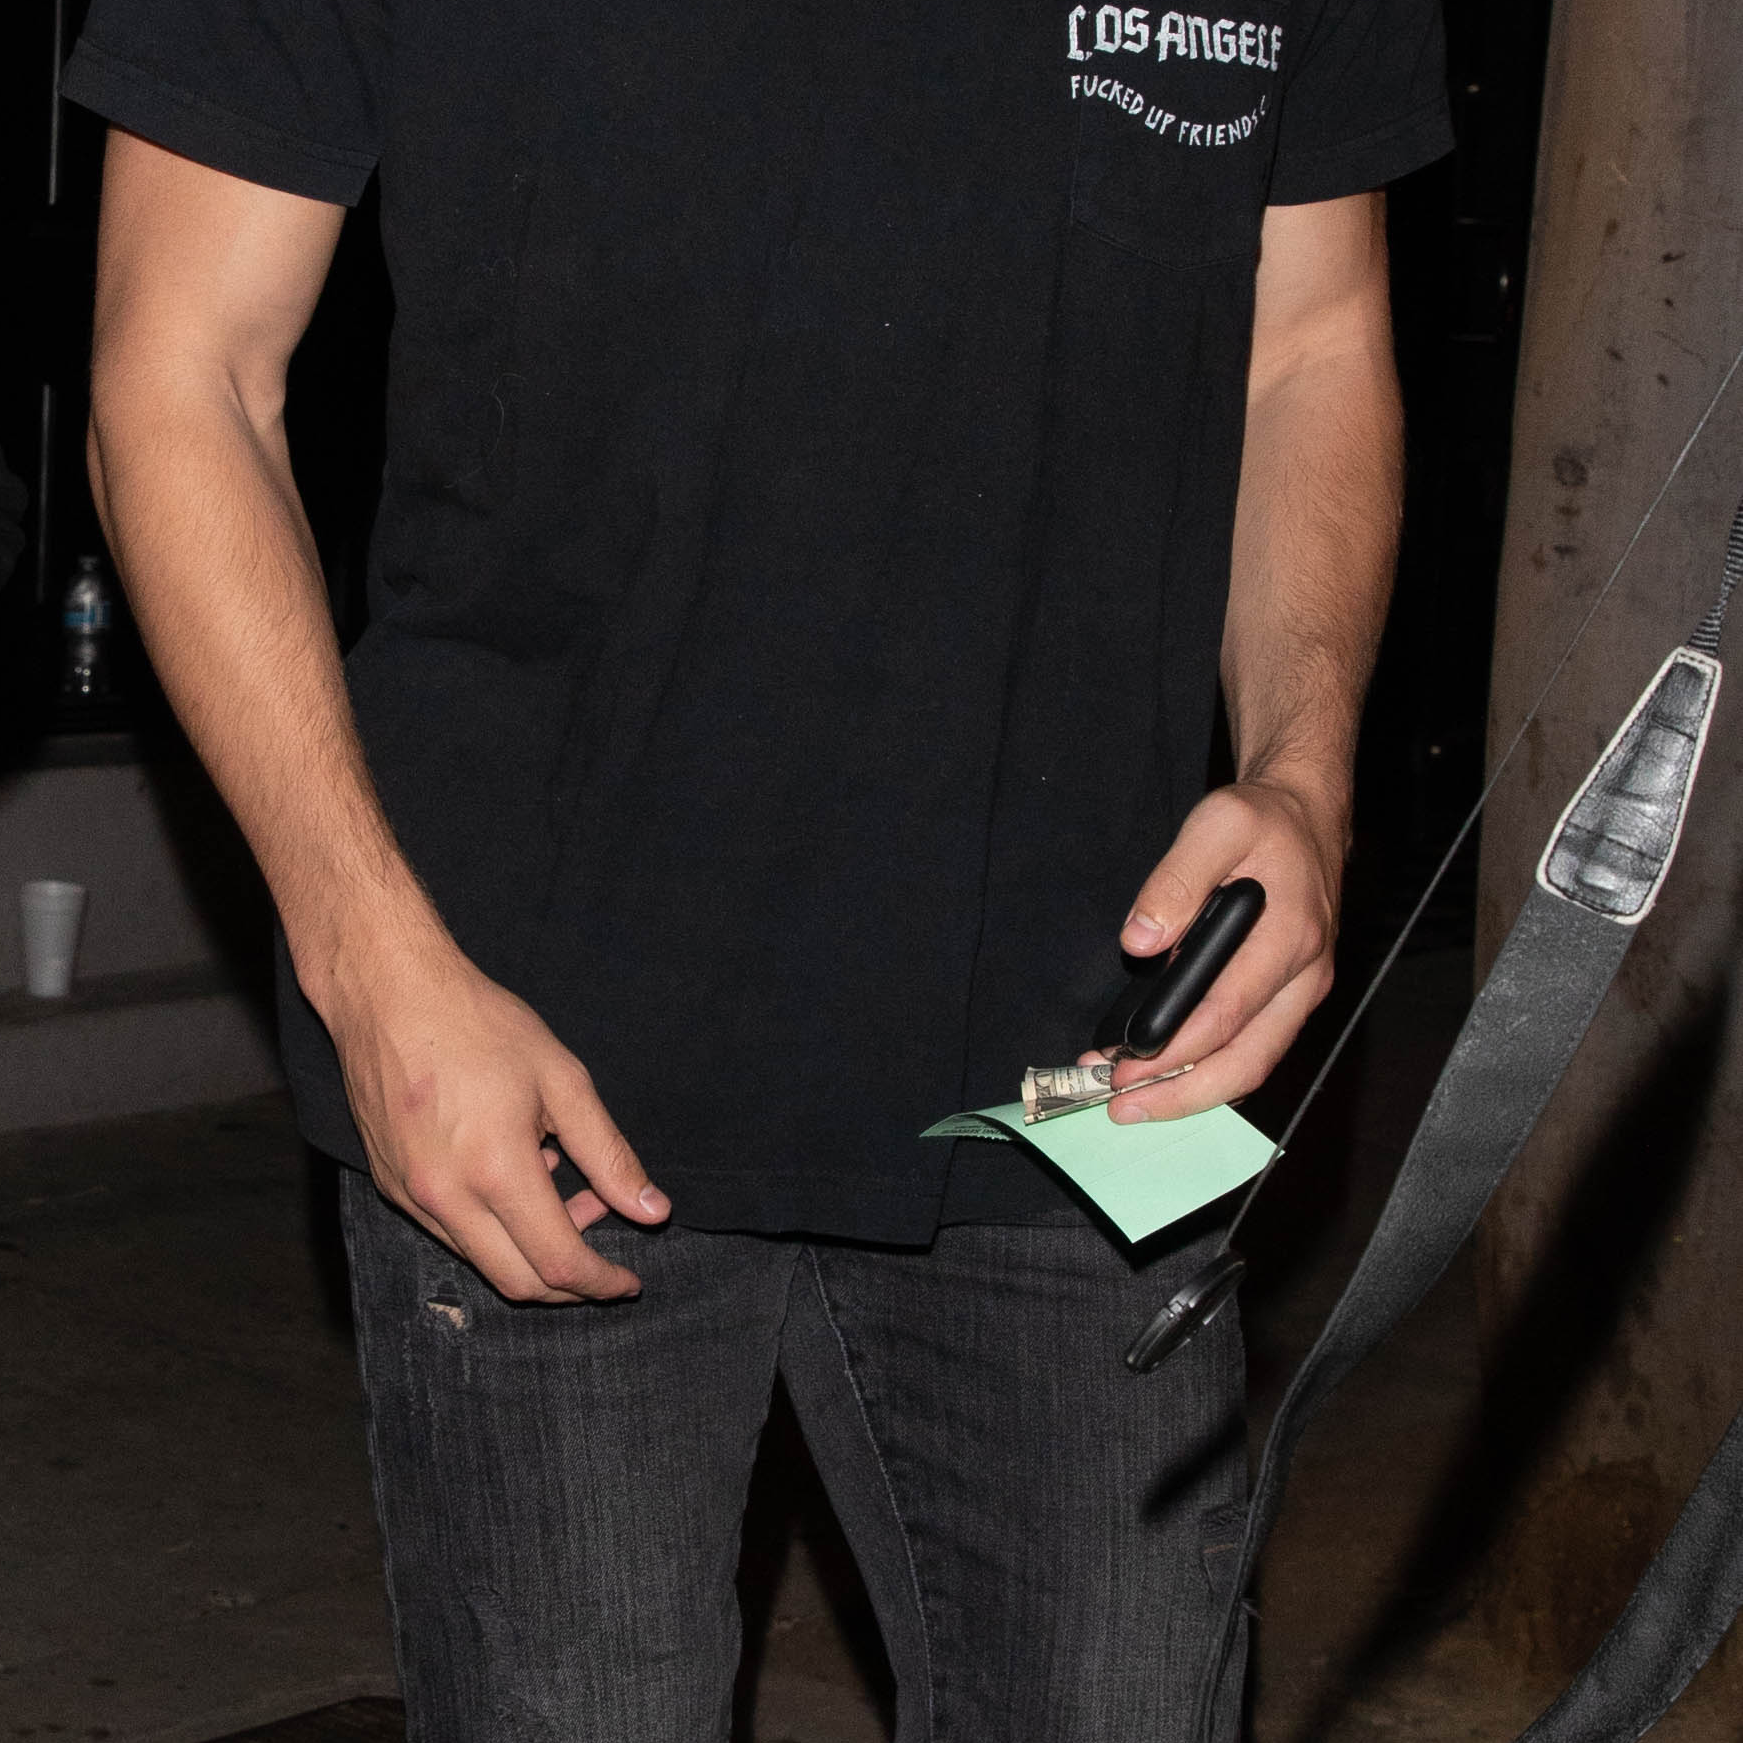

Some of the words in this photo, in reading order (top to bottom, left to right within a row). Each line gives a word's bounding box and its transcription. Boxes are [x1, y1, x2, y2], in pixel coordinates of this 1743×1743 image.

[1066, 4, 1150, 61] LOS
[1153, 10, 1283, 72] ANGELE
[1070, 74, 1145, 116] FUCKED
[1144, 97, 1177, 136] UP
